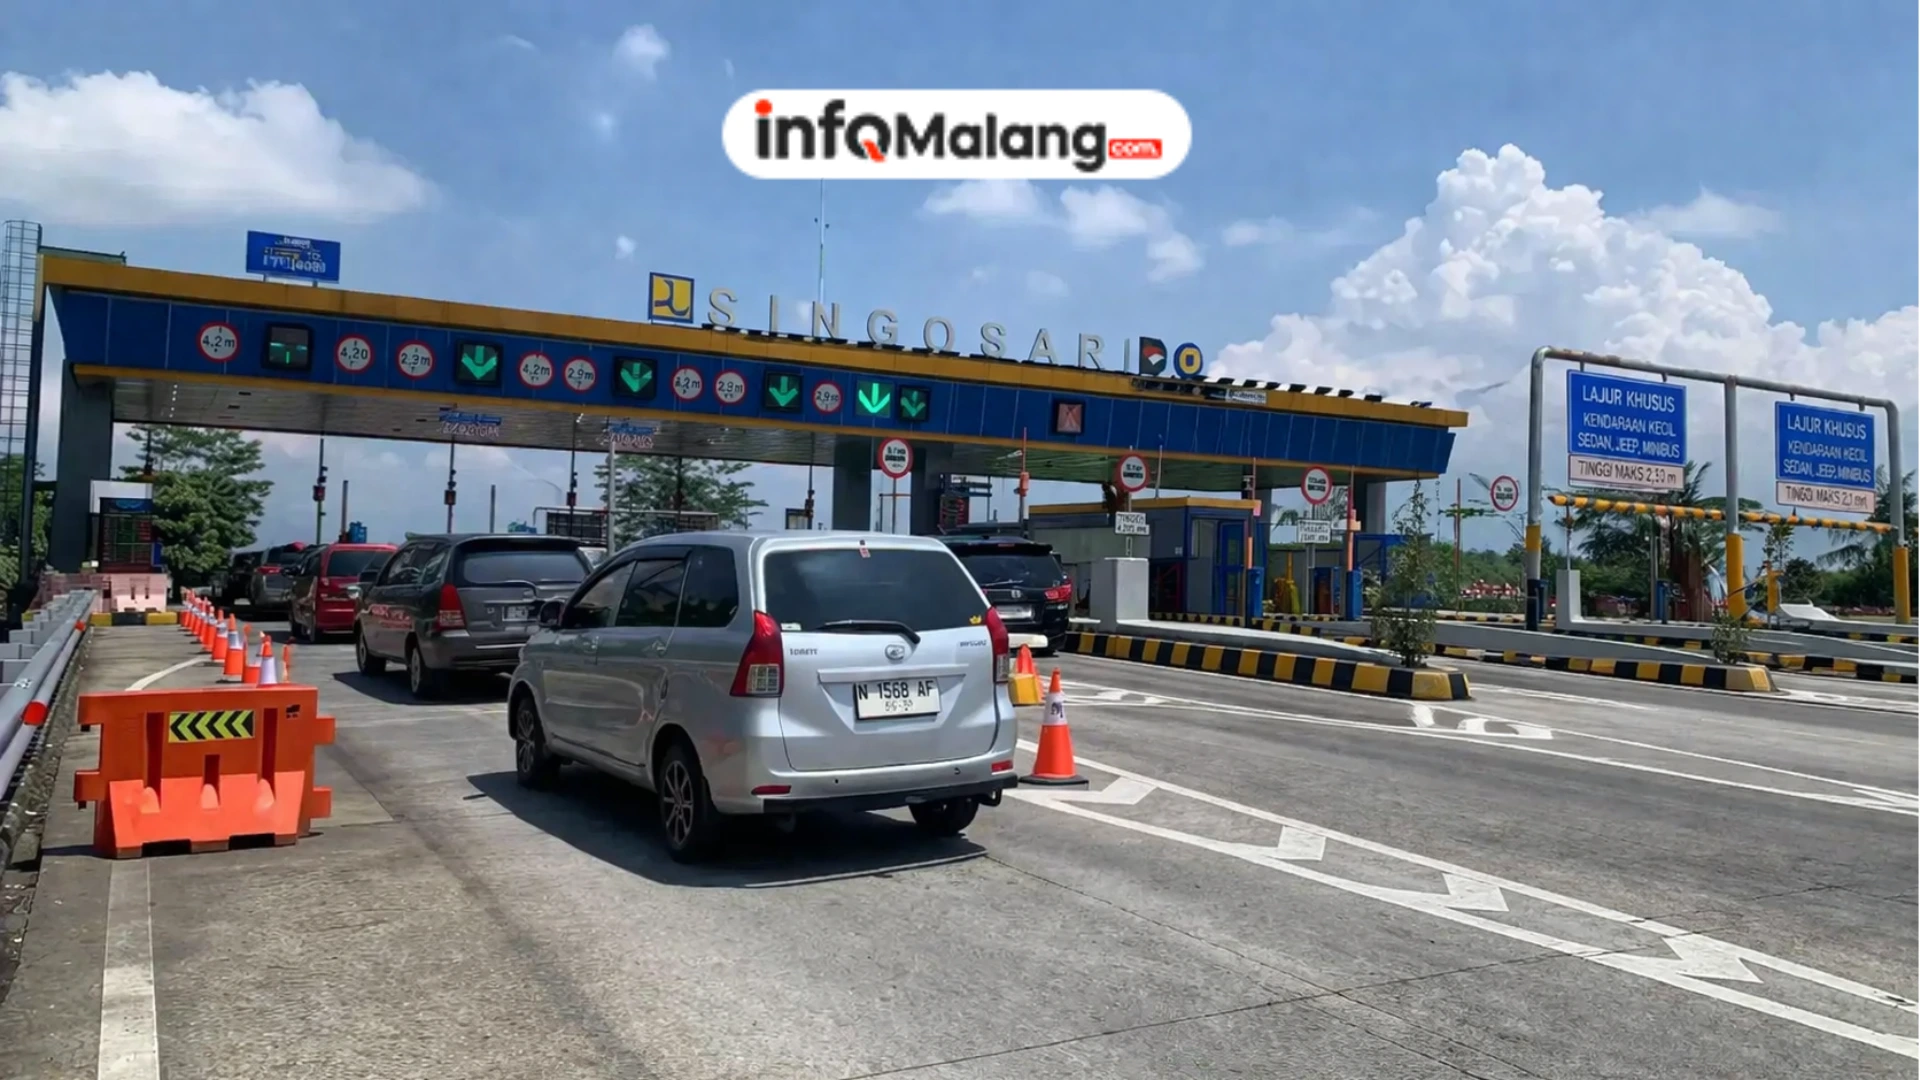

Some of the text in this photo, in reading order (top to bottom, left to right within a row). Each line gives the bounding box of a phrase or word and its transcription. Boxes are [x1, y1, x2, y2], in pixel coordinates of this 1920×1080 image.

[708, 287, 1130, 374] SINGOSARI
[1583, 385, 1676, 413] LAJUR KHUSUS
[1583, 412, 1677, 437] KENDARAAN KECIL
[1787, 413, 1867, 440] LAJUR KHUSUS
[1642, 441, 1680, 458] MINIBUS
[1578, 460, 1612, 477] TINGGI
[1615, 465, 1643, 482] MAKS
[858, 680, 934, 700] N 1568 AF
